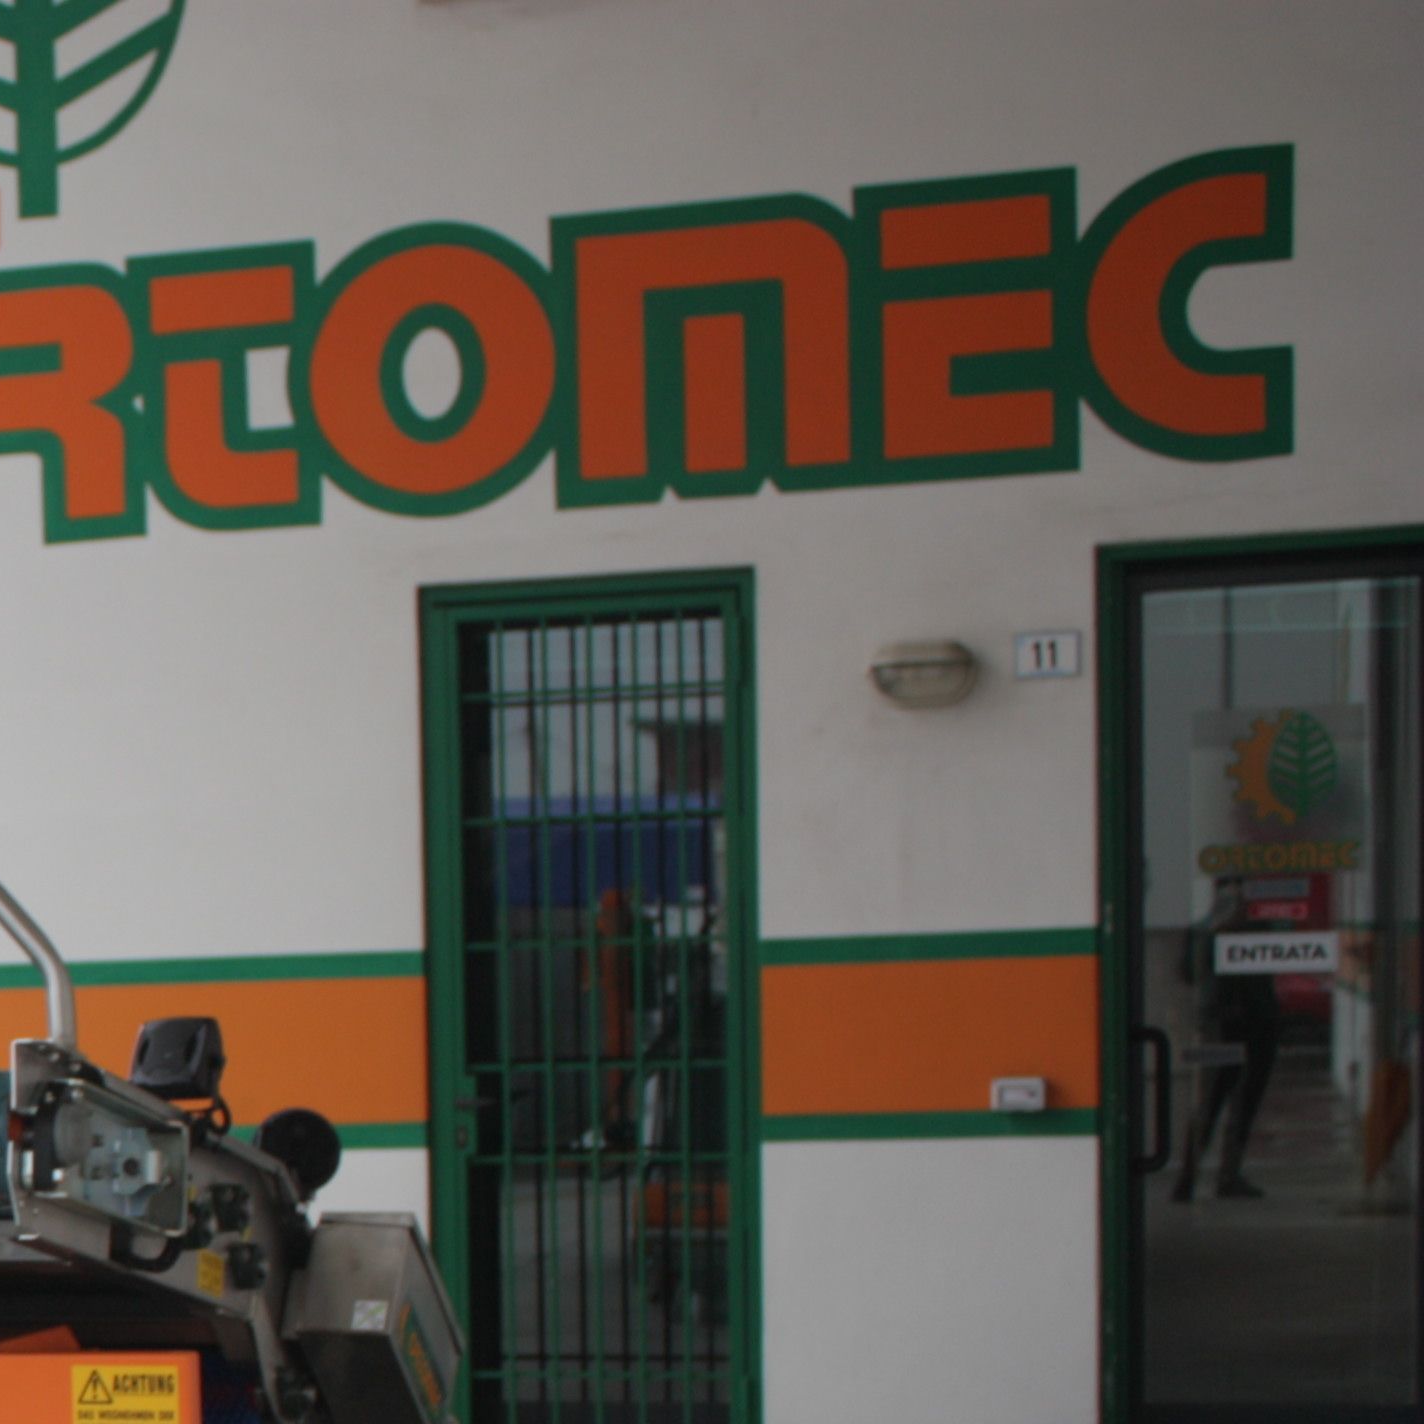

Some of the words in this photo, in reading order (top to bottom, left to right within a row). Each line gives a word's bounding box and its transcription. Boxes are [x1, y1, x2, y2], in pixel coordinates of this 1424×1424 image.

[1031, 640, 1057, 670] 11
[1225, 943, 1328, 963] ENTRATA
[113, 1373, 175, 1394] ACHTUNG
